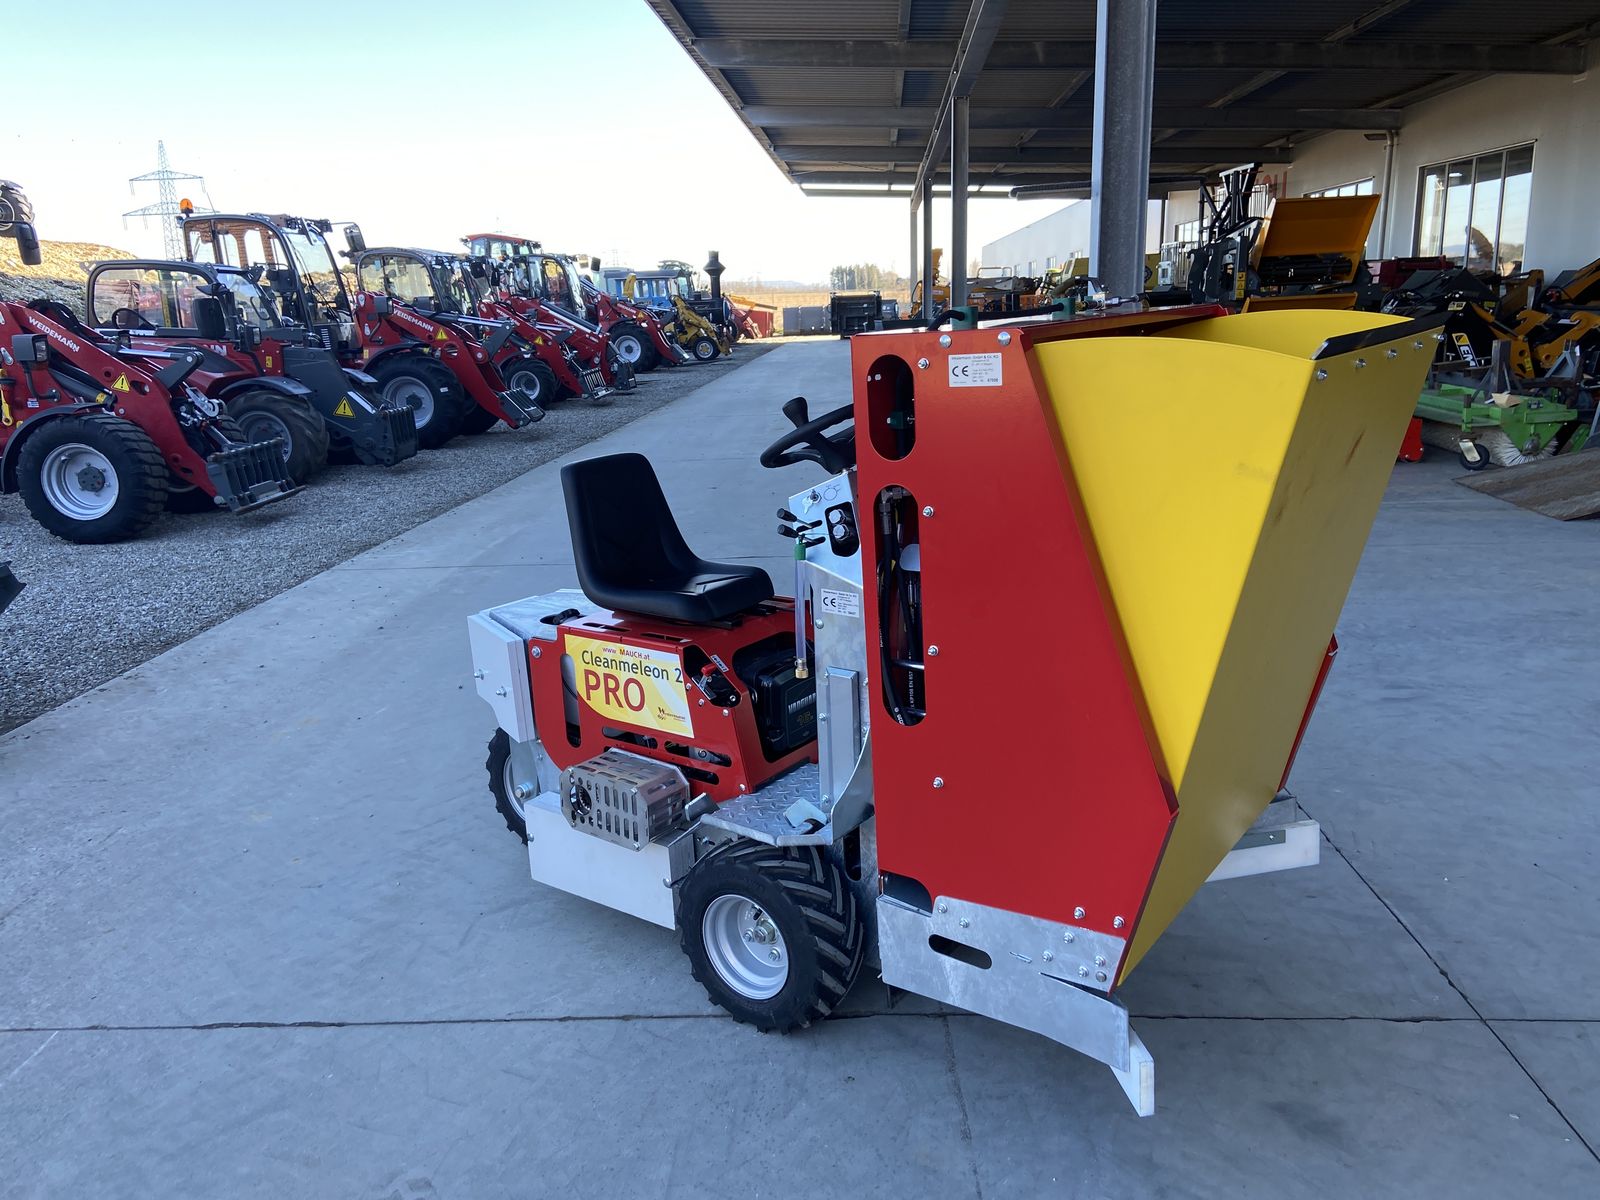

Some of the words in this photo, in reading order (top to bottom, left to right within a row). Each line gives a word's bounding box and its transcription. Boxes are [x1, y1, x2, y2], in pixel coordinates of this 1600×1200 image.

[28, 315, 80, 353] WEIDEMANN
[580, 650, 669, 680] Cleanmeleon
[674, 667, 684, 684] 2
[583, 668, 646, 713] PRO
[787, 692, 816, 715] VANGUAR
